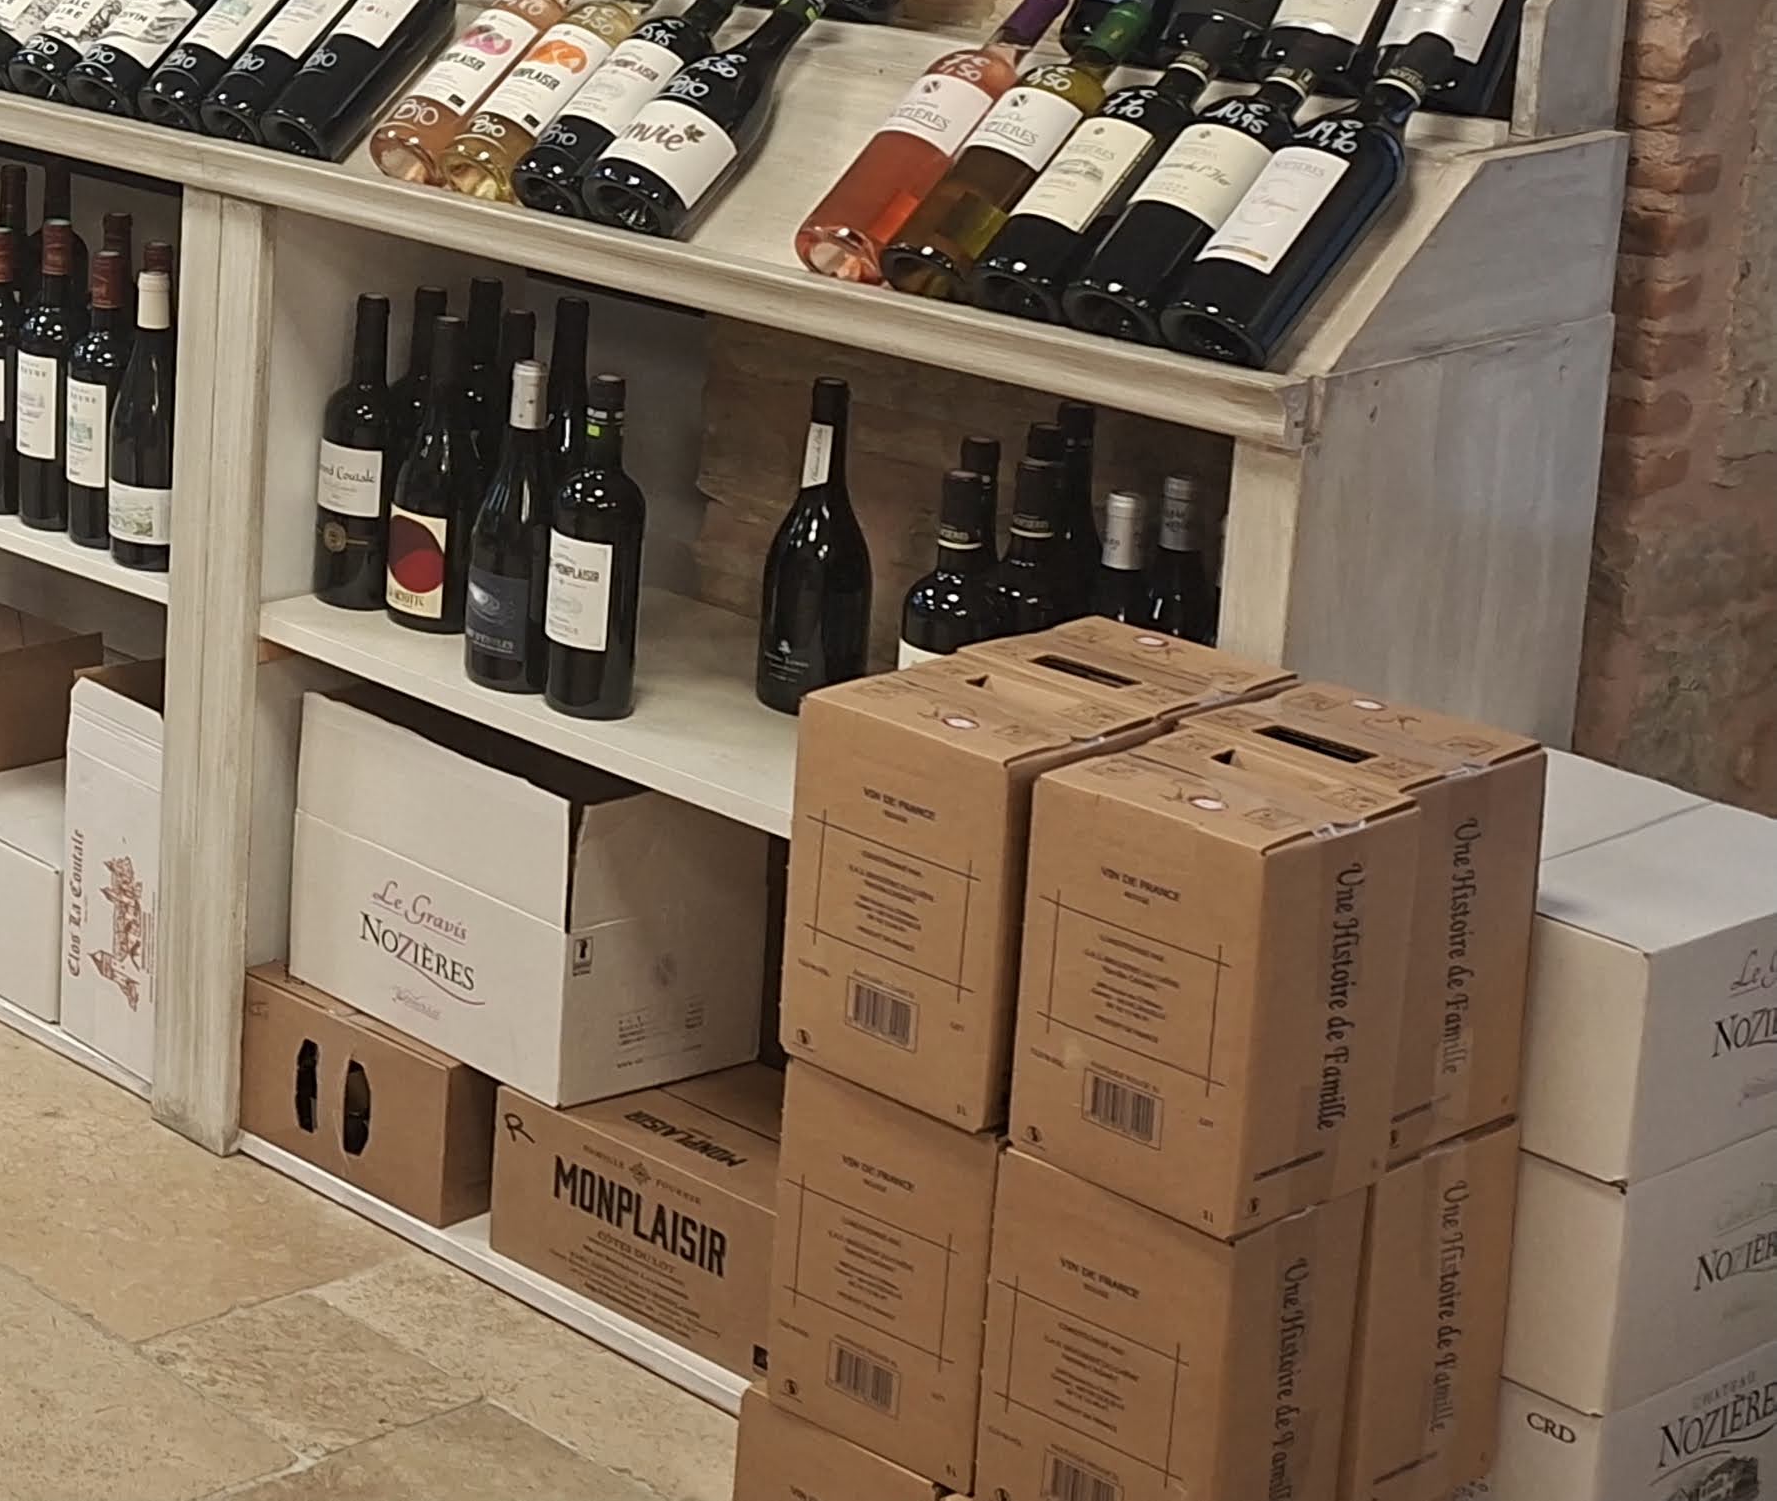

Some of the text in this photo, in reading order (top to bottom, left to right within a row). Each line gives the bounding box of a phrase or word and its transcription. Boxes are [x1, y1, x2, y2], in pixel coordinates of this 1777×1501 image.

[882, 793, 897, 808] DE
[898, 798, 937, 823] FRANCE
[67, 828, 86, 978] Clos La Coutale
[372, 879, 468, 942] Le Gravis
[1122, 872, 1137, 889] DE
[1139, 879, 1183, 903] FRANCE
[359, 911, 477, 993] NOZIÈRES
[1441, 815, 1483, 1076] Une Histoire de Famille
[1315, 861, 1366, 1133] Une Histoire de Famille
[552, 1153, 728, 1279] MONPLAISIR
[1082, 1265, 1099, 1283] DE
[1100, 1270, 1140, 1300] FRANCE
[1435, 1323, 1463, 1351] de
[1273, 1402, 1301, 1430] de
[1525, 1411, 1577, 1445] CRD
